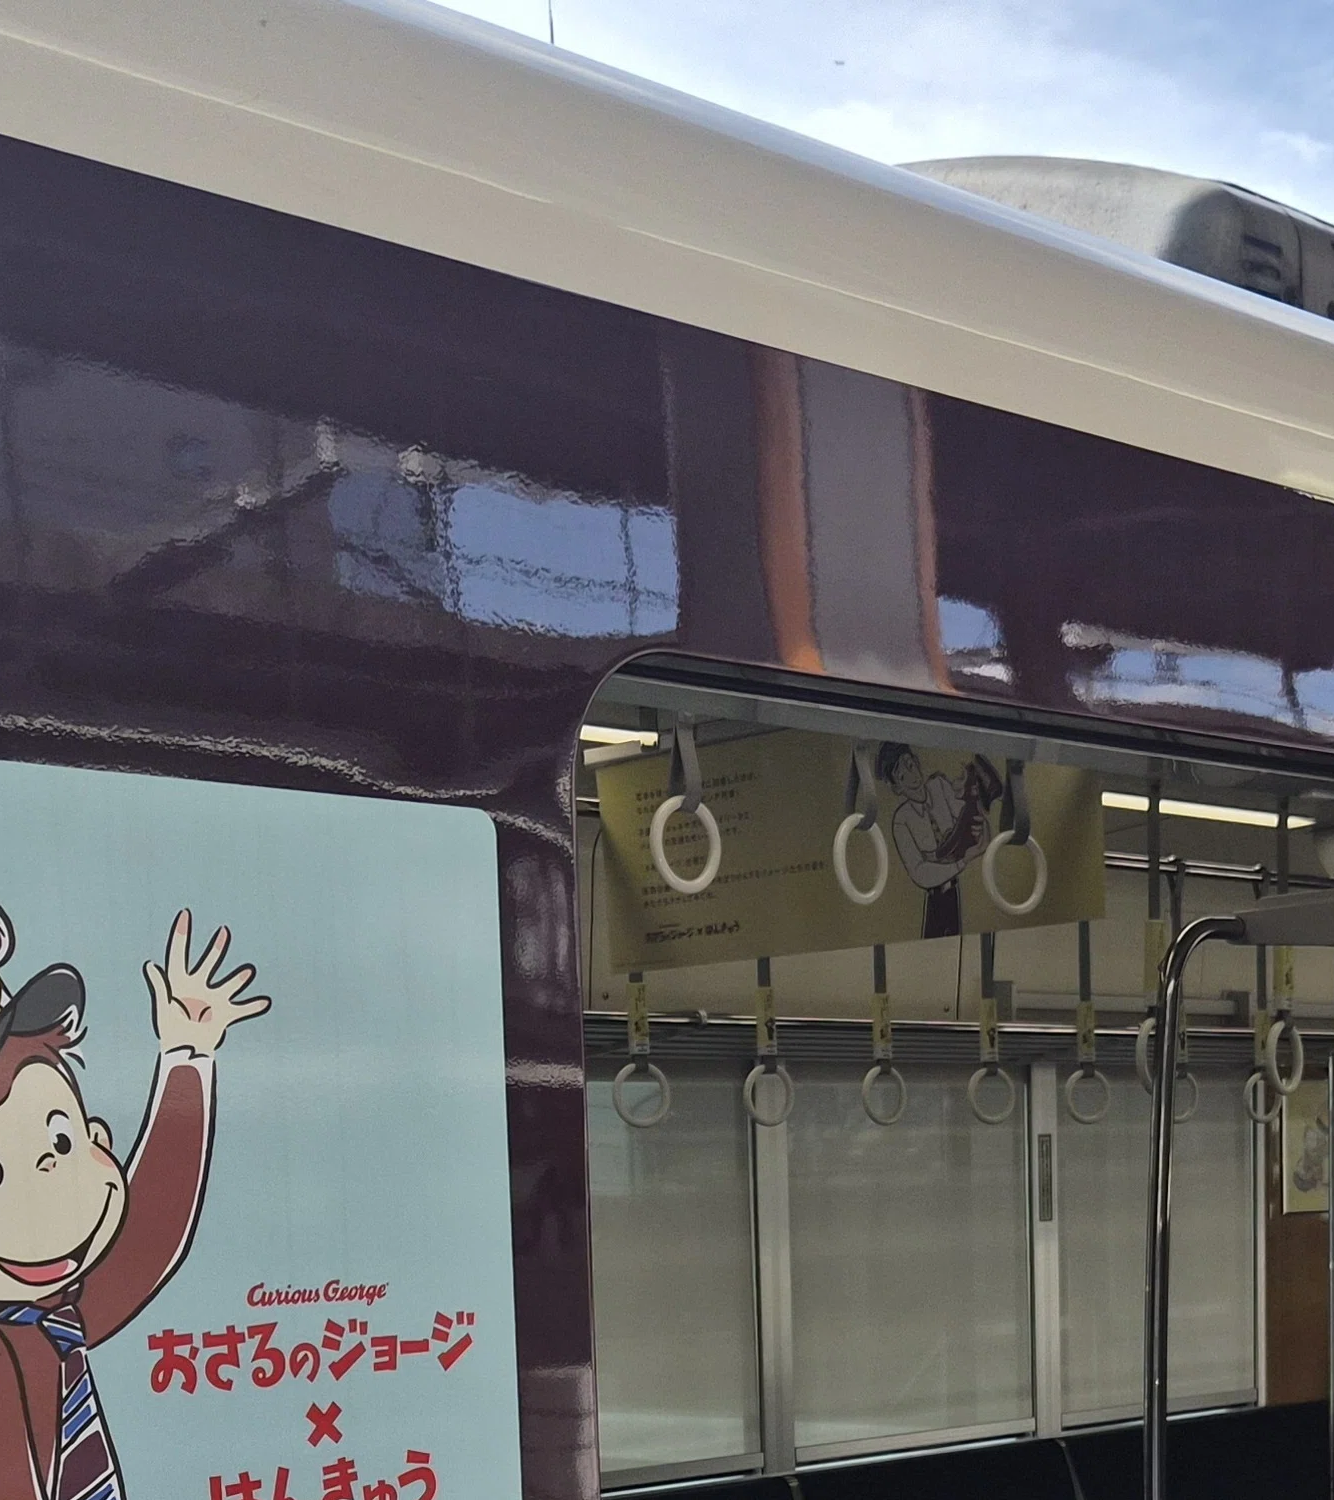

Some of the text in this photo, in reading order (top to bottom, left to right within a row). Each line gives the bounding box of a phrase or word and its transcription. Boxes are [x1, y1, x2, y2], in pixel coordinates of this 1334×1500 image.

[246, 1279, 388, 1307] Curious George
[147, 1310, 476, 1395] おさるのジョージ
